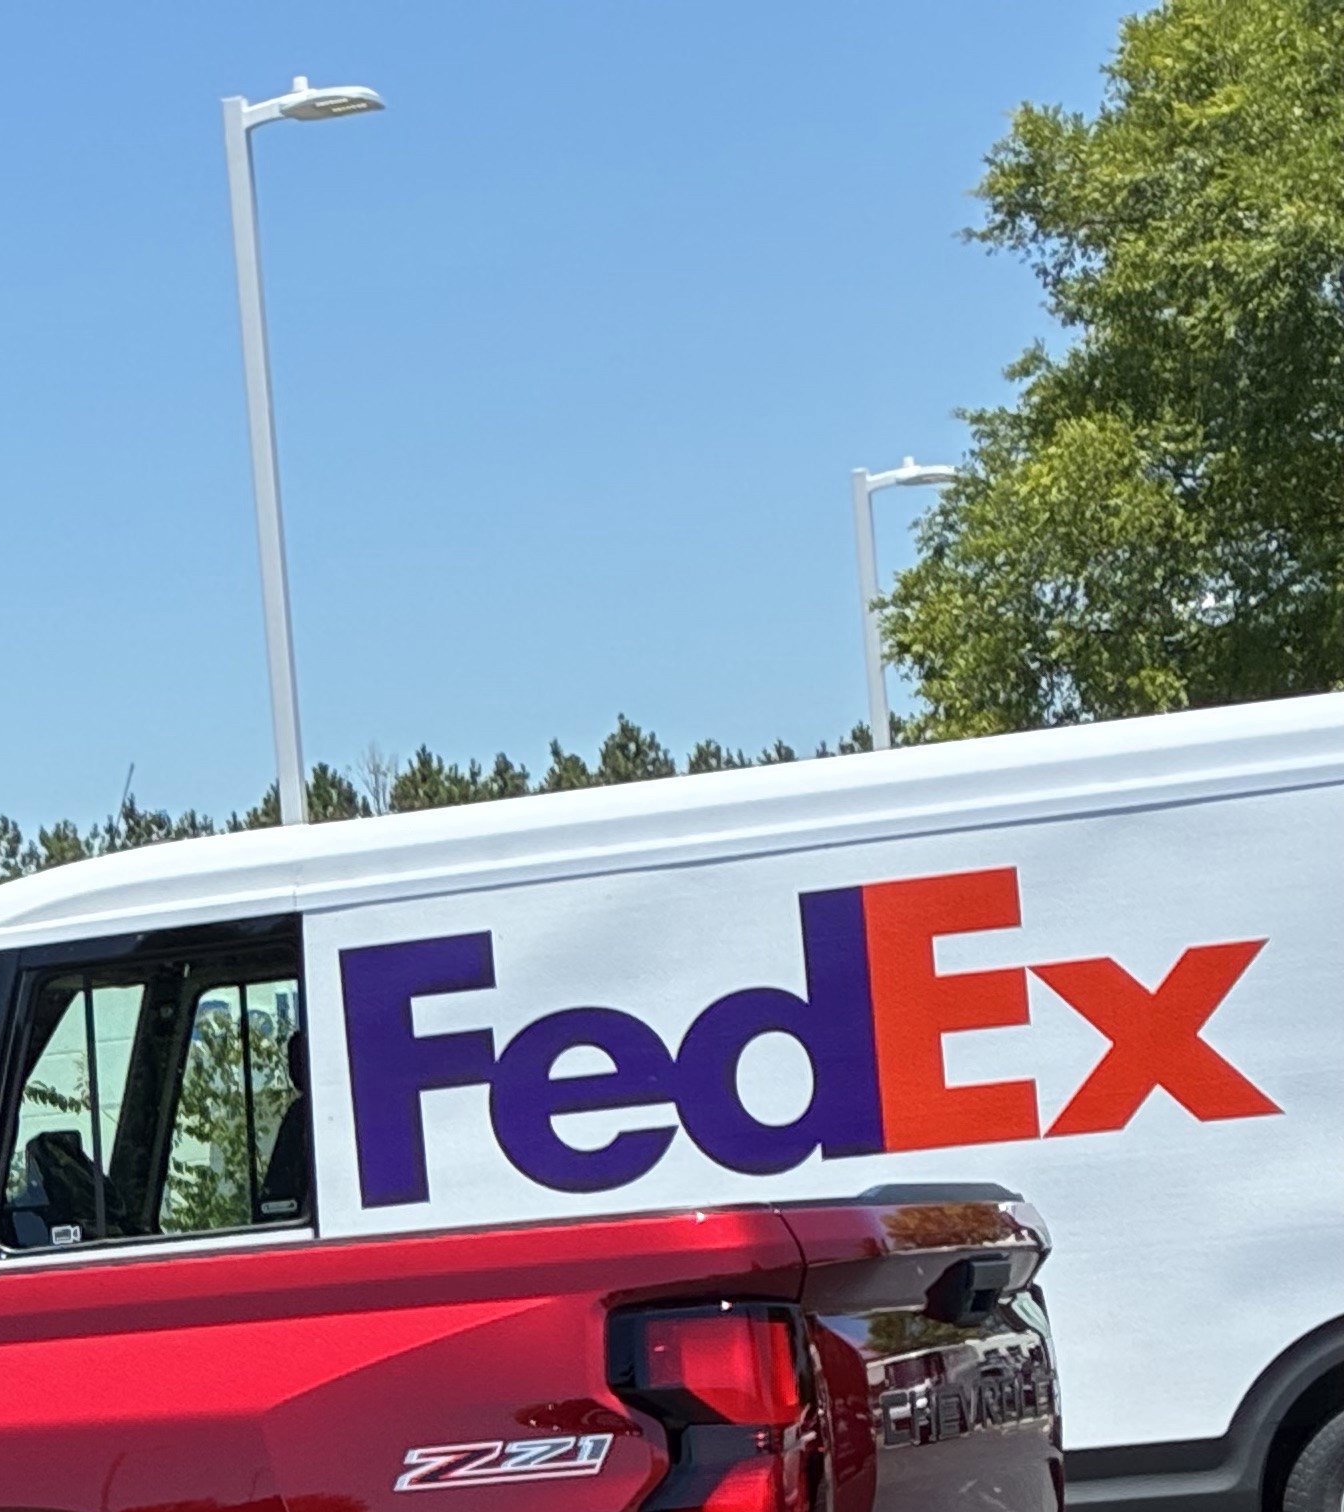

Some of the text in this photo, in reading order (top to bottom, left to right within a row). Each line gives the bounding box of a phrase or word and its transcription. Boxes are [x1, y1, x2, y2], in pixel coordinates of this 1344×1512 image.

[338, 866, 1285, 1208] FedEx
[879, 1380, 1050, 1445] CHEVROLE
[394, 1433, 613, 1491] Z71
